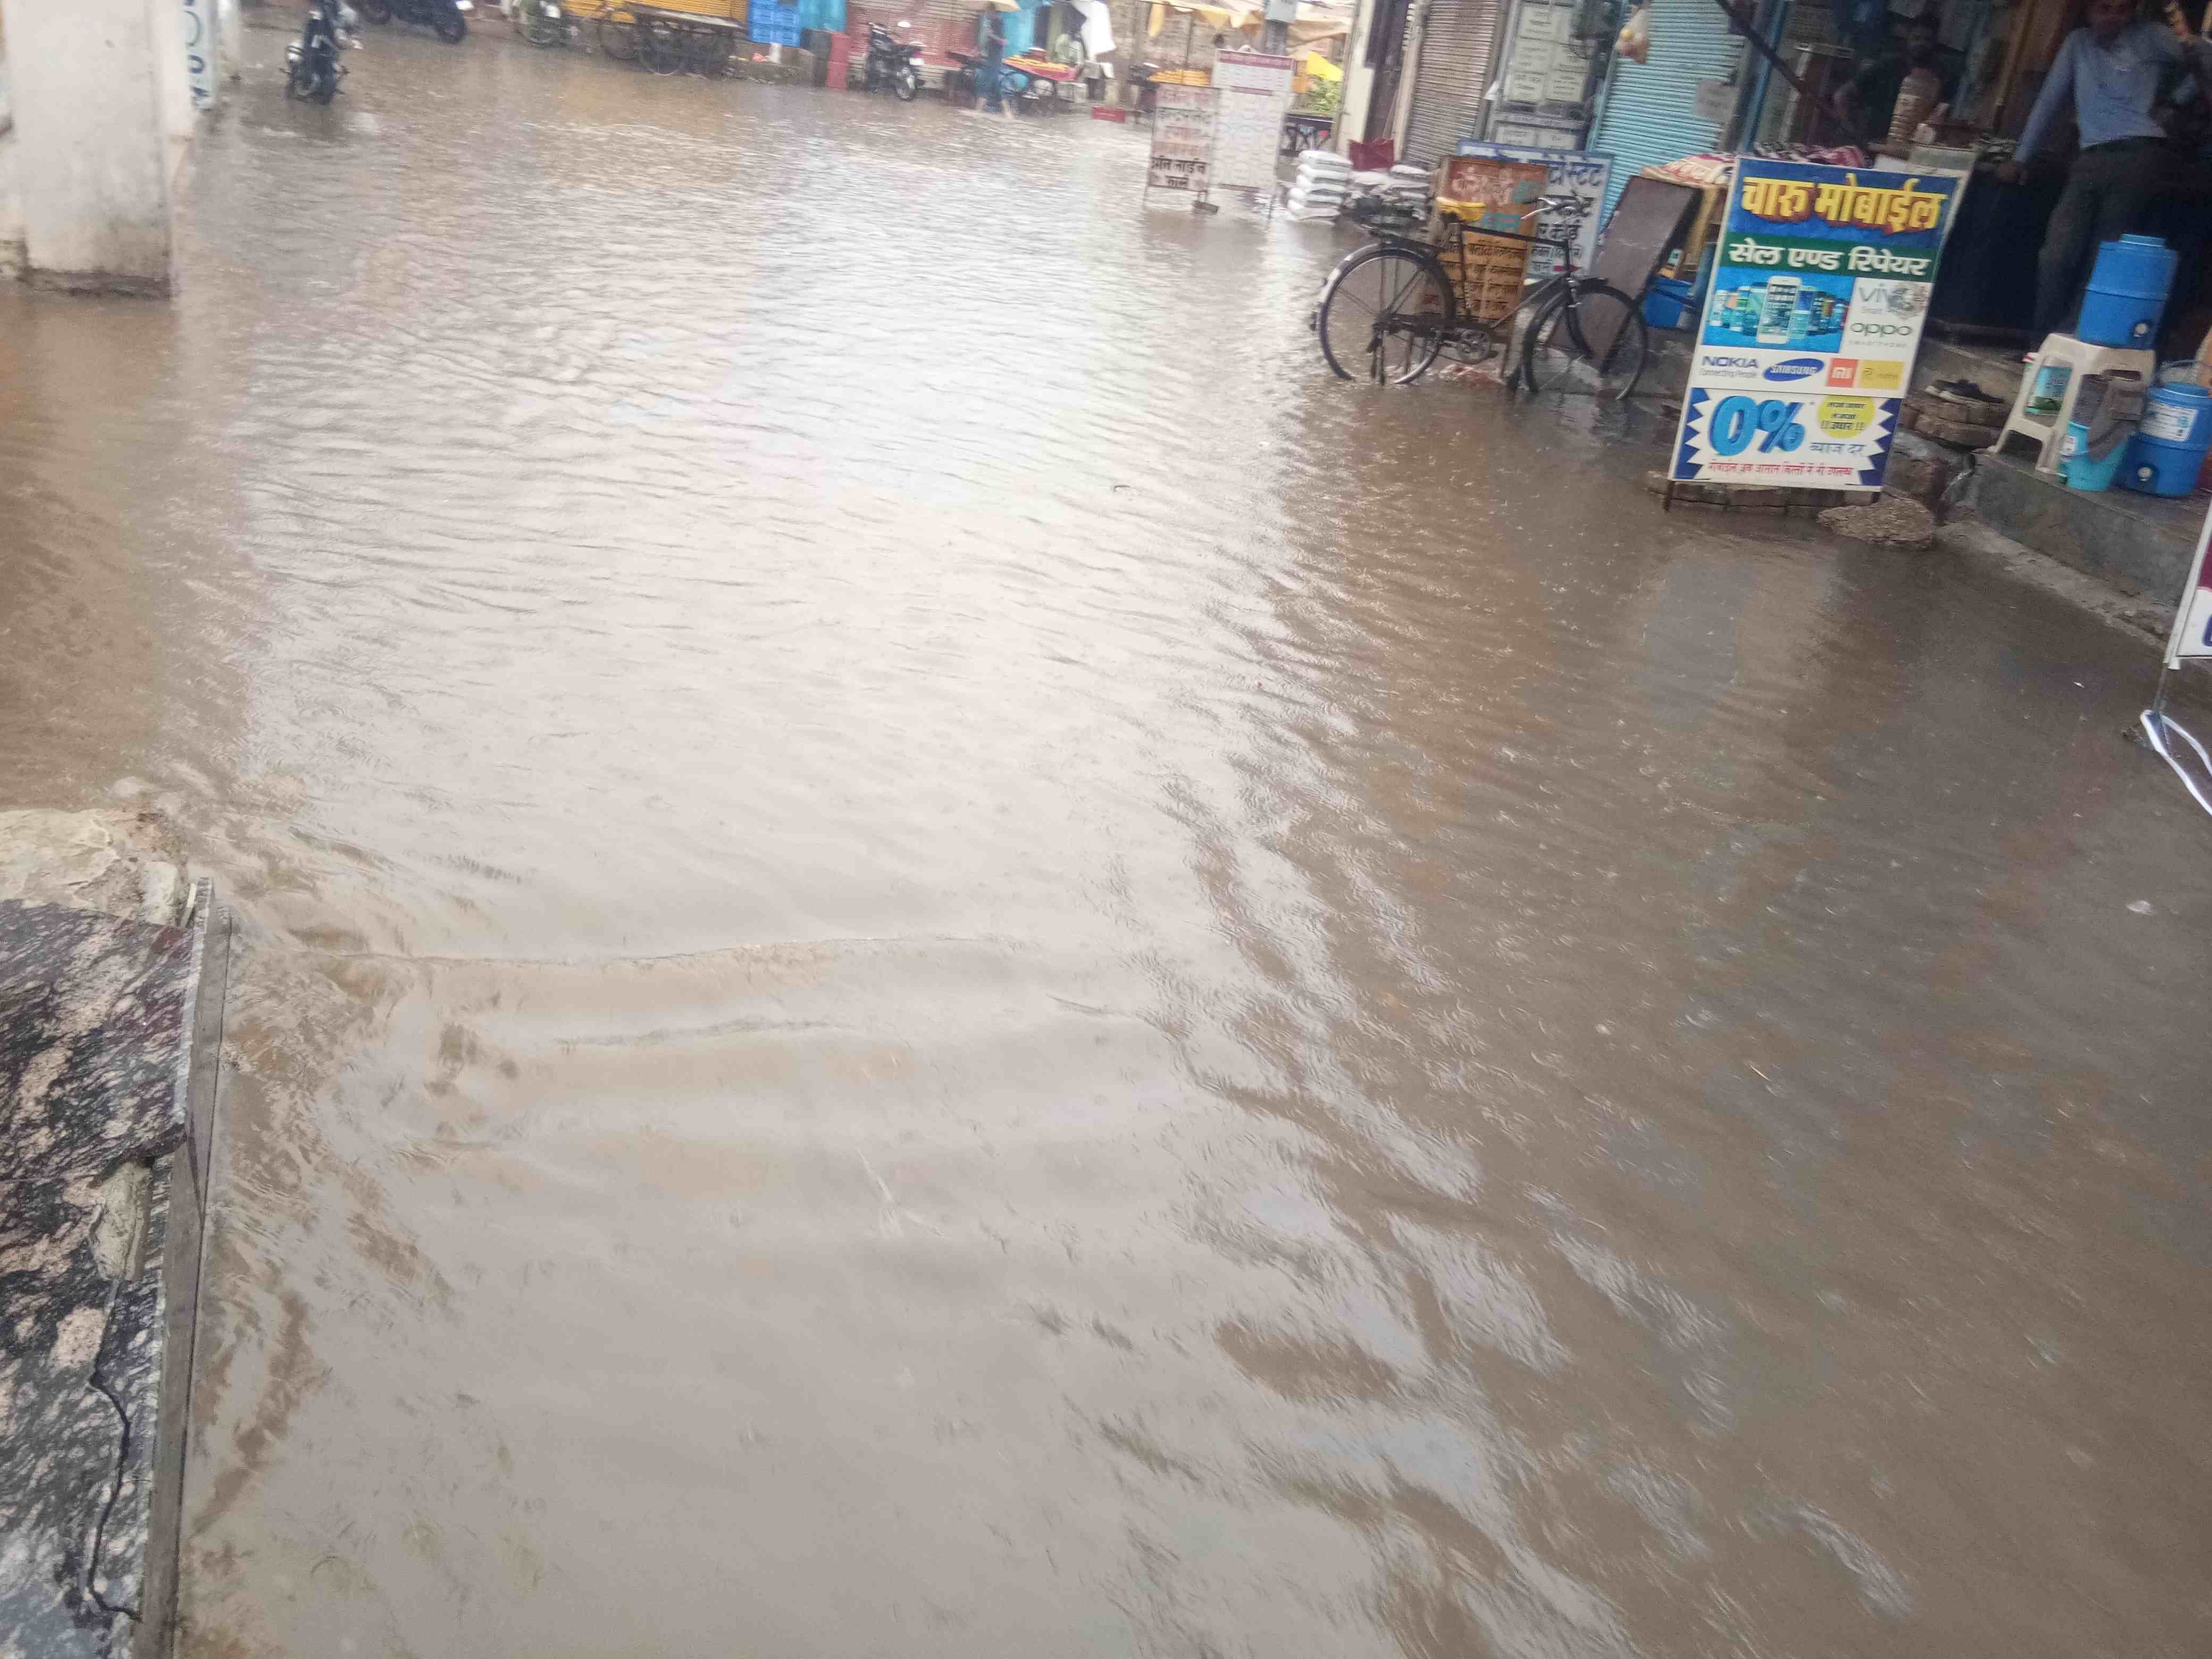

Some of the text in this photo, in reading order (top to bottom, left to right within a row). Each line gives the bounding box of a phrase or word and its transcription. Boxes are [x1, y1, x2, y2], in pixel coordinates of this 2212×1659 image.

[1741, 173, 1948, 234] चारु मोबाईल
[1729, 237, 1932, 276] सेल एण्ड रिपेयर
[1702, 356, 1759, 368] NOKIA
[1770, 365, 1818, 375] SAMSUNG
[1708, 396, 1805, 456] 0%
